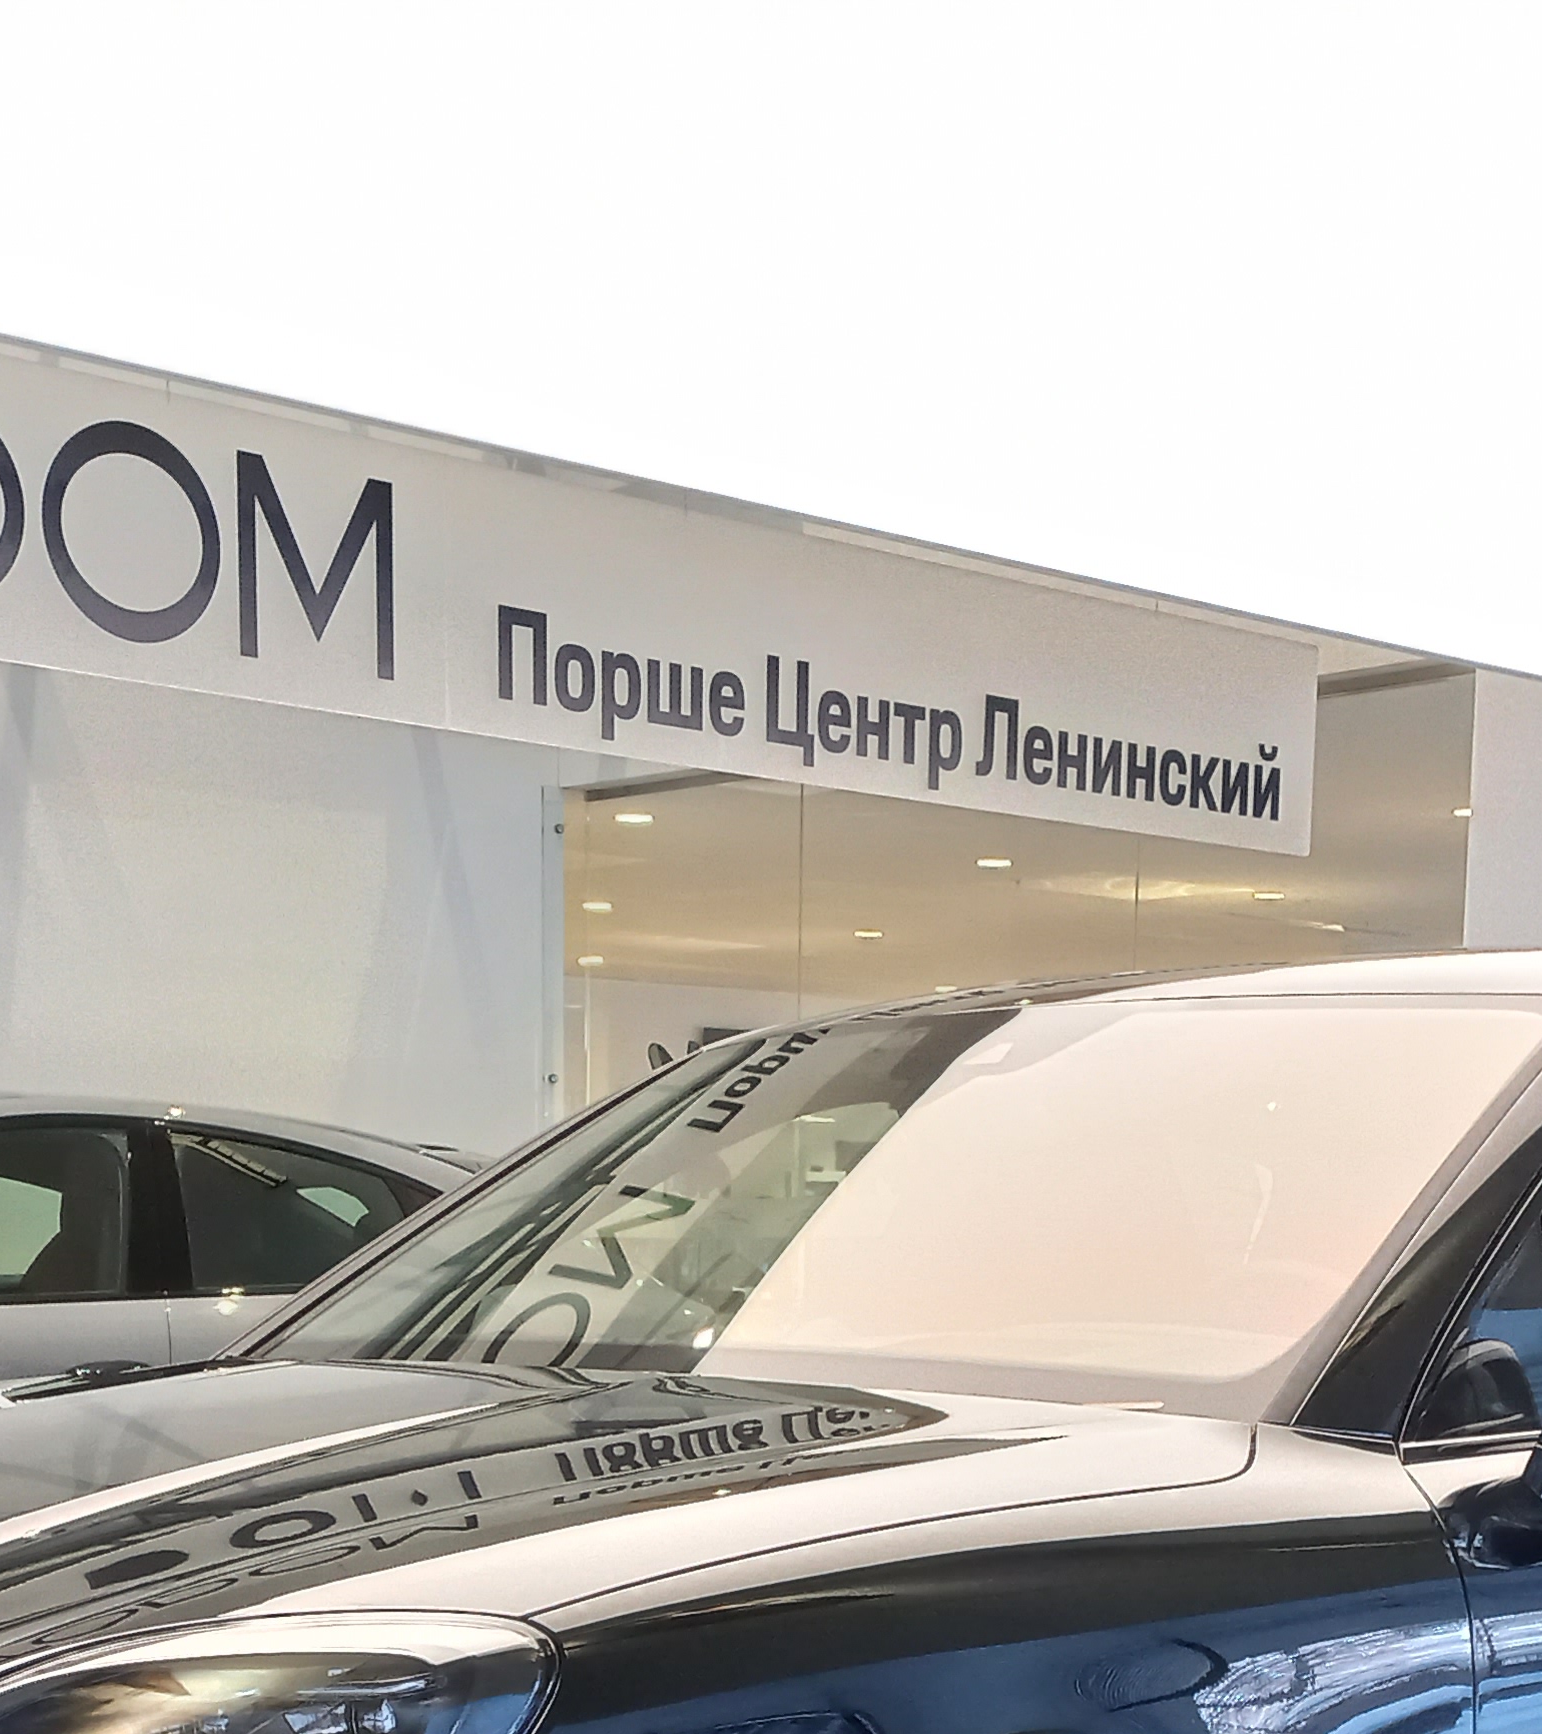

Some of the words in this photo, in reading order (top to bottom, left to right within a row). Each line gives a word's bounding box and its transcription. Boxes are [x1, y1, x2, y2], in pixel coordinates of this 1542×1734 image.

[497, 604, 745, 741] Порше
[765, 655, 963, 789] Центр
[974, 694, 1281, 822] Ленинский
